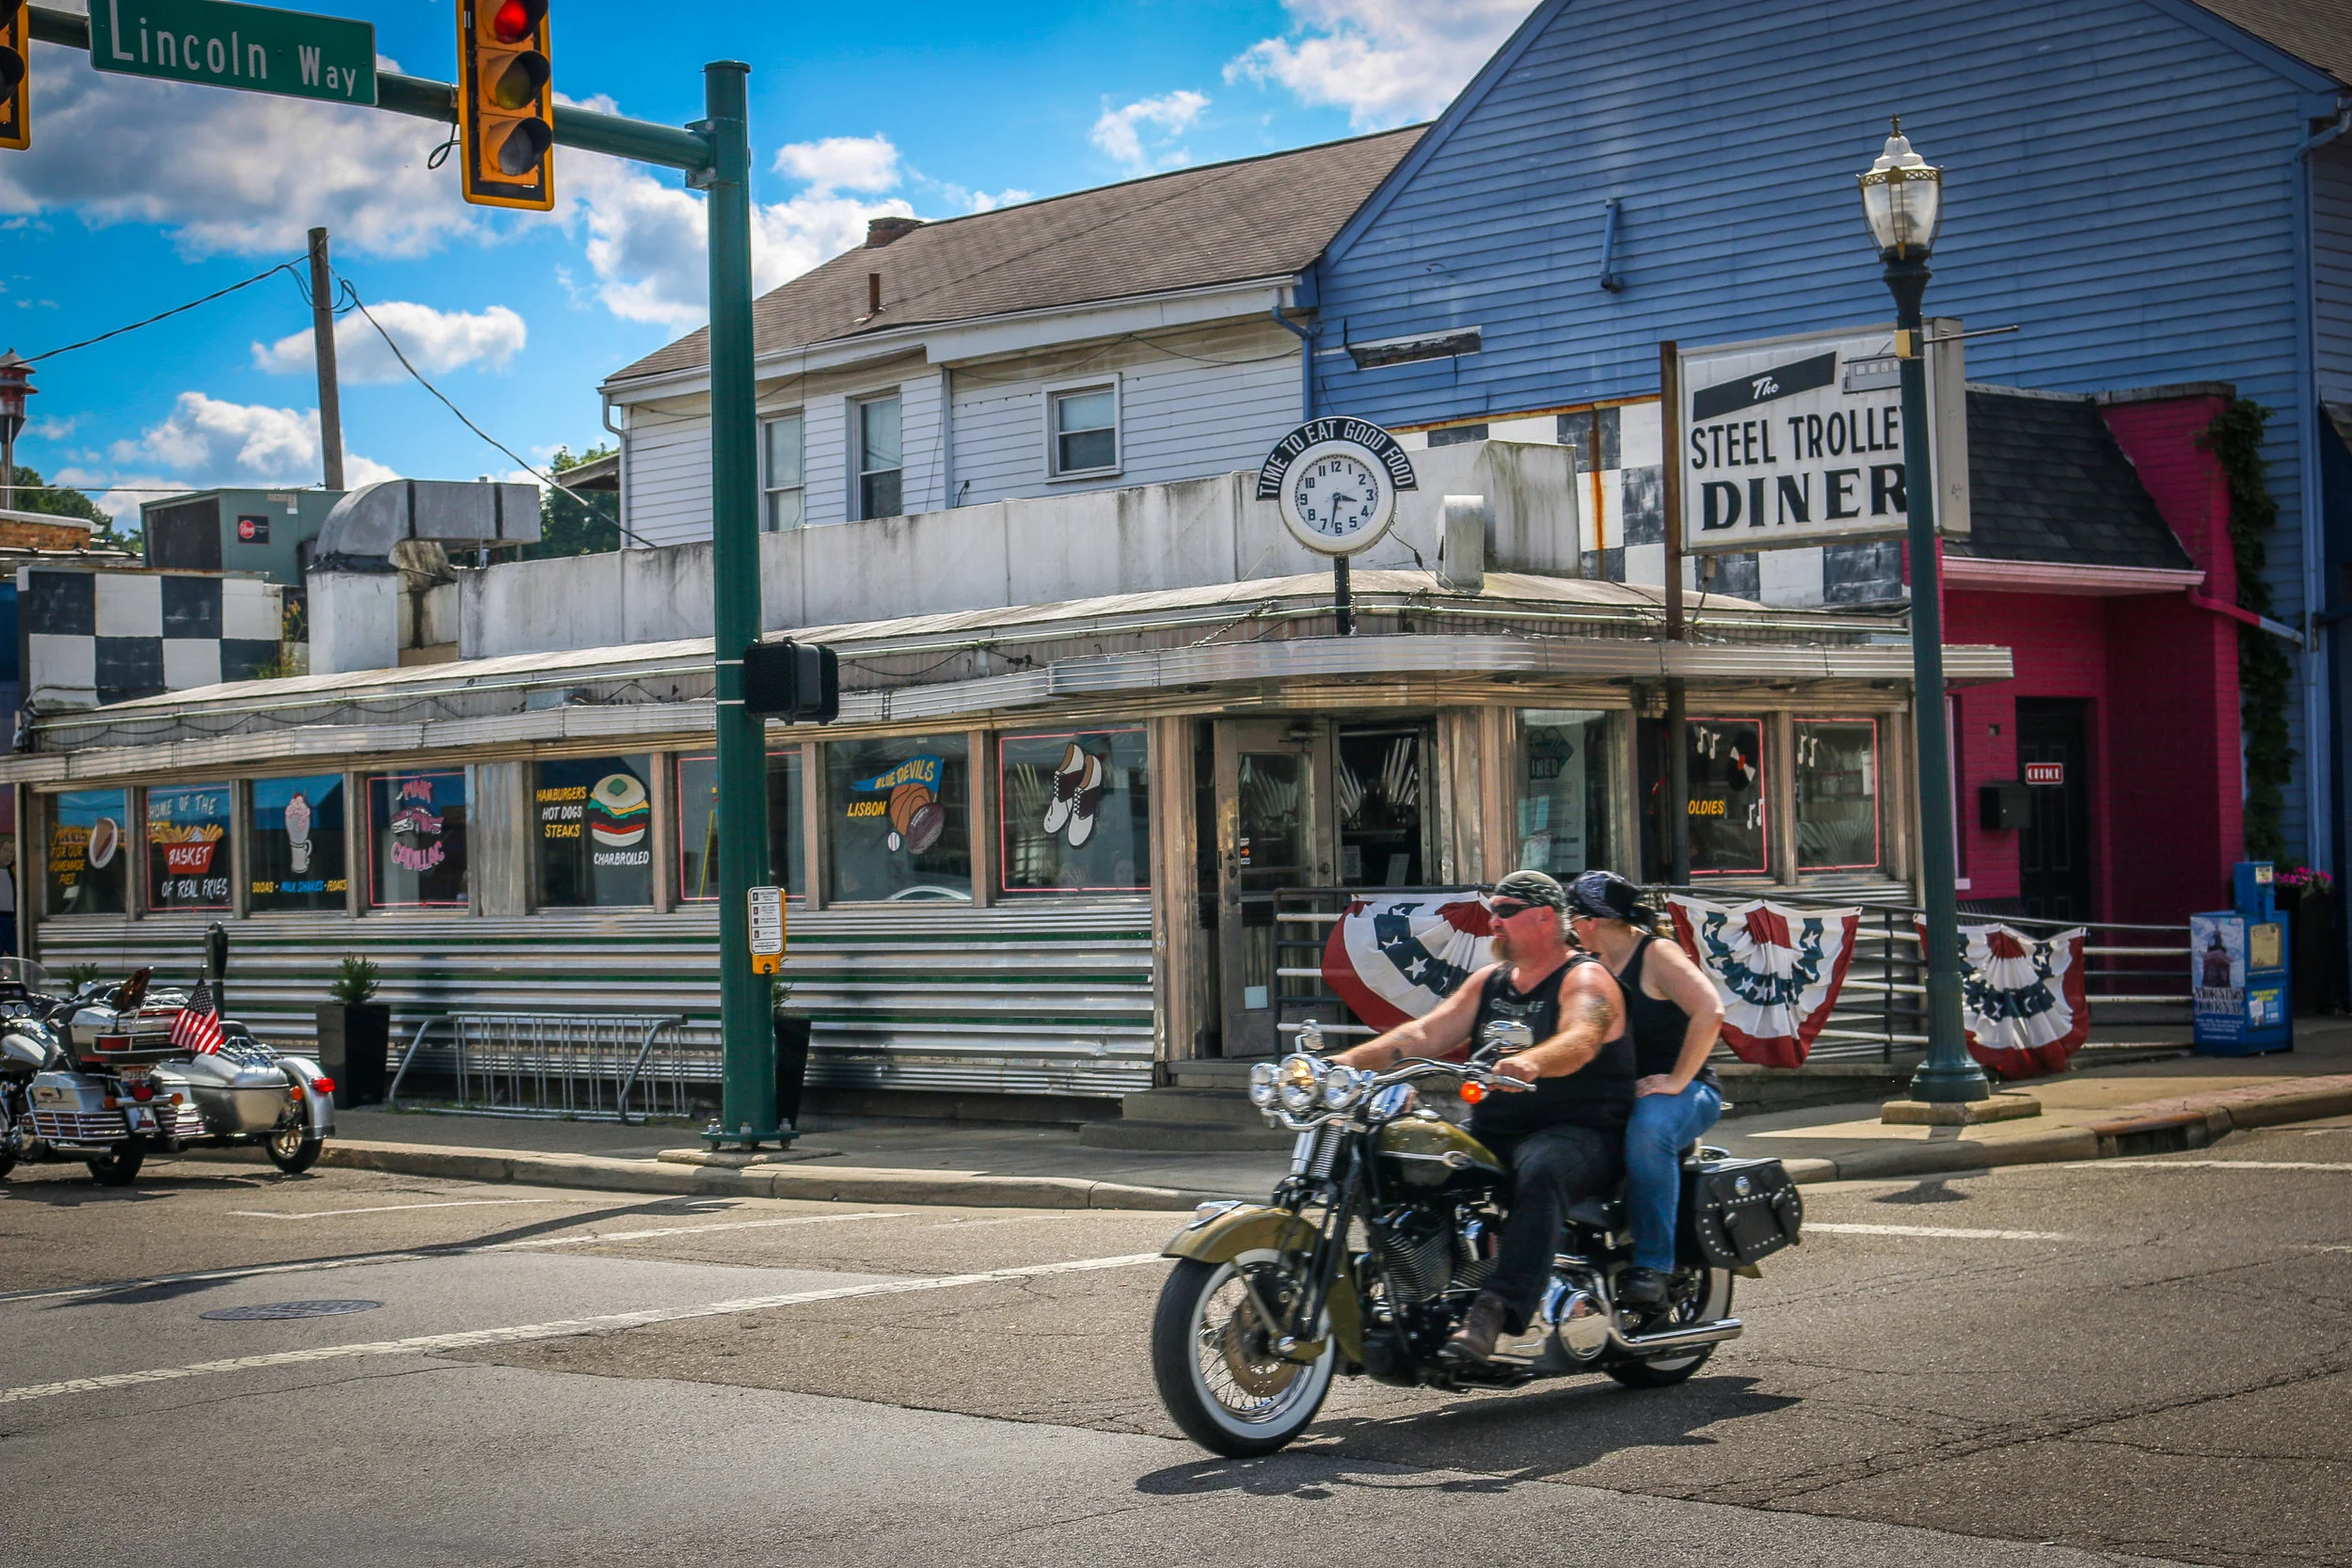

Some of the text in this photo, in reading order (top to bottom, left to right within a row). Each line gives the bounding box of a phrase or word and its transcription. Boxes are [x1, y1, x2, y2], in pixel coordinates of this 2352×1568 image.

[110, 0, 357, 96] Lincoln Way
[1752, 376, 1780, 400] The
[1691, 404, 1903, 470] STEEL TROLLE
[1259, 420, 1414, 497] TIME TO EAT GOOD FOOD
[1318, 465, 1327, 477] 11
[1331, 461, 1342, 472] 12
[1347, 463, 1352, 474] 1
[1305, 477, 1315, 489] 10
[1358, 473, 1366, 485] 2
[1299, 494, 1308, 505] 9
[1365, 489, 1374, 501] 3
[1700, 462, 1908, 531] DINER
[1308, 508, 1316, 520] 8
[1360, 505, 1369, 517] 4
[1320, 518, 1327, 530] 7
[1334, 522, 1343, 534] 6
[1349, 516, 1358, 529] 5
[874, 759, 934, 789] BLUE DEVILS
[1530, 757, 1560, 777] INER
[2028, 767, 2060, 780] OFFICE
[403, 780, 433, 803] PINK
[536, 786, 587, 802] HAMBURGERS
[149, 794, 217, 819] HOME OF THE
[542, 805, 583, 820] HOT DOGS
[847, 800, 887, 817] LISBON
[1688, 800, 1724, 816] OLDIES
[545, 824, 580, 838] STEAKS
[168, 846, 212, 866] BASKET
[390, 841, 445, 871] CADILLAC
[593, 850, 650, 865] CHARBROILED
[162, 877, 229, 899] OF REAL FRIES
[251, 881, 274, 894] SODAS
